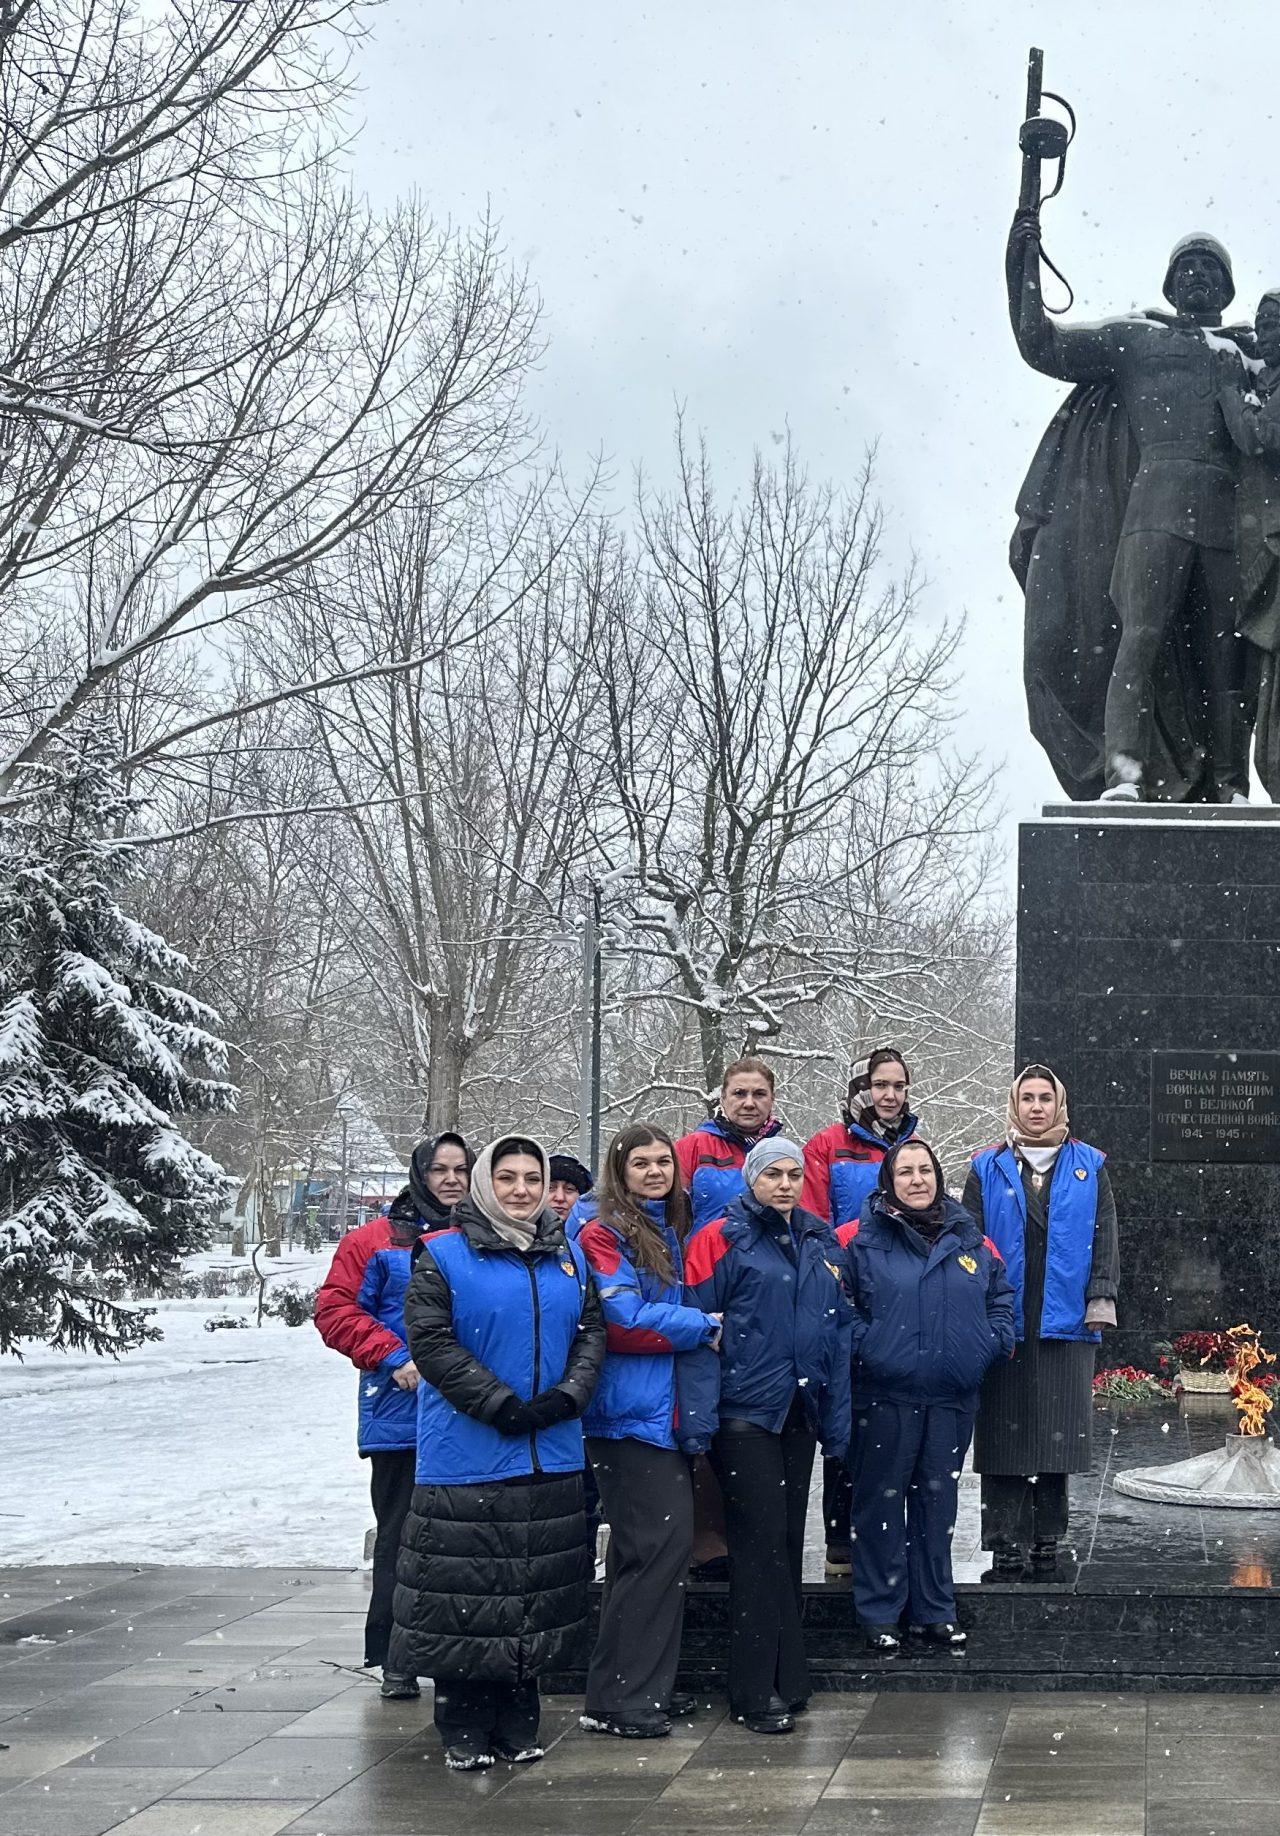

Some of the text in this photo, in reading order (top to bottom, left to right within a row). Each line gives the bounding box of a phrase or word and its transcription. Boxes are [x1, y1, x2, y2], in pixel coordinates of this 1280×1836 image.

[1169, 1069, 1270, 1081] ВЕЧНАЯ ПАМЯТЬ
[1166, 1084, 1274, 1096] ВОИНАМ ПАВШИМ
[1200, 1098, 1254, 1110] ВЕЛИКОЙ
[1157, 1112, 1280, 1125] ОТЕЧЕСТВЕННОЙ ВОЙНЕ
